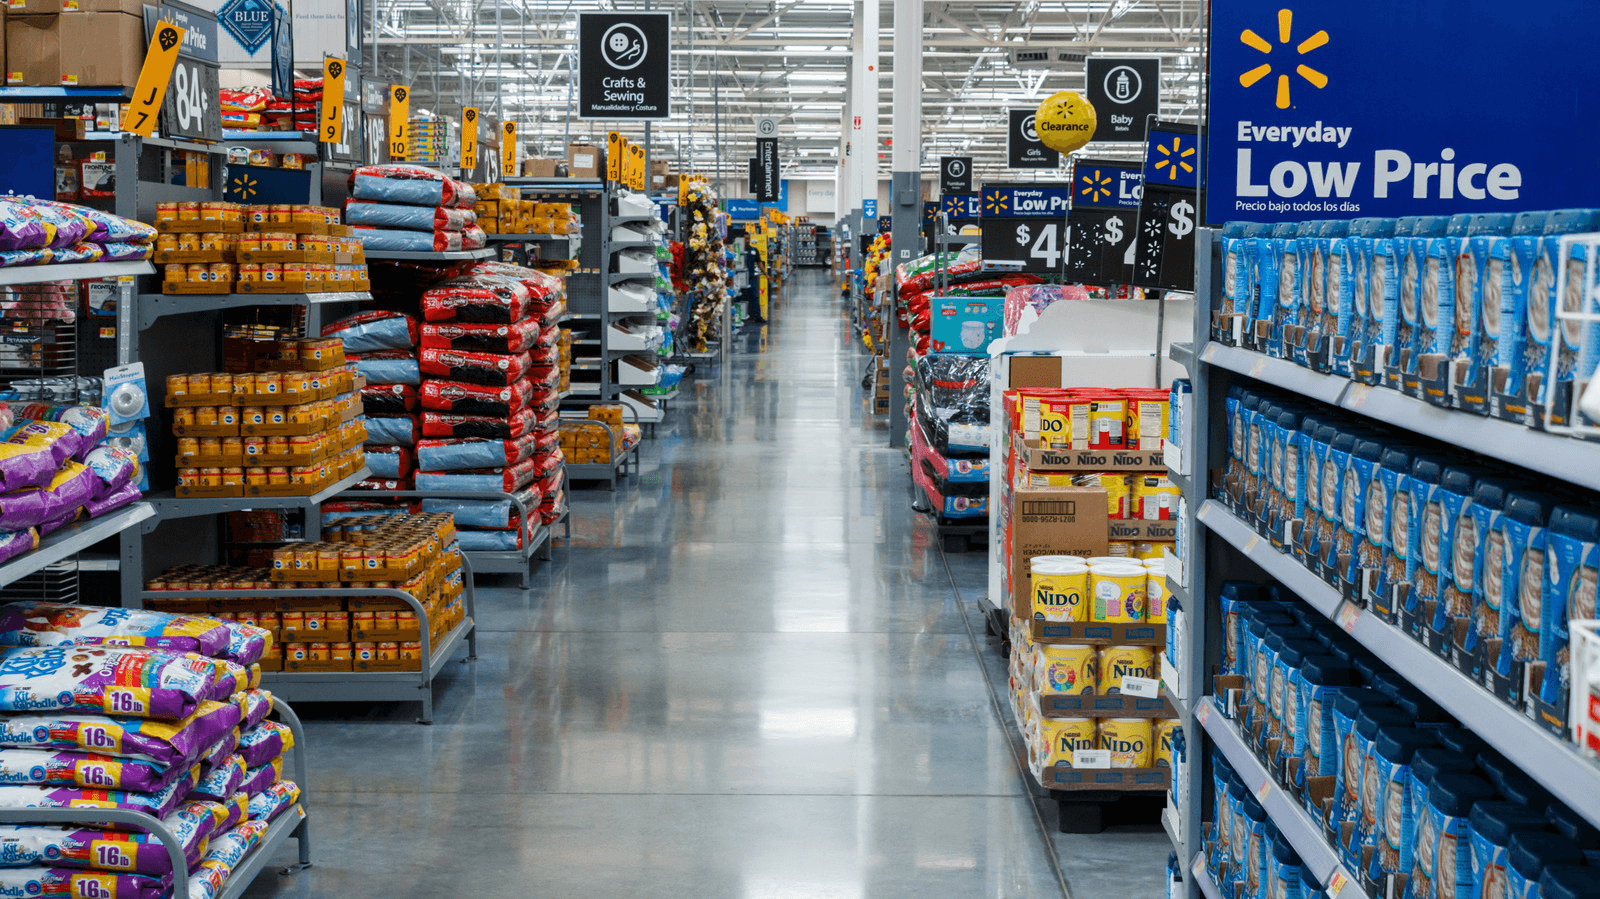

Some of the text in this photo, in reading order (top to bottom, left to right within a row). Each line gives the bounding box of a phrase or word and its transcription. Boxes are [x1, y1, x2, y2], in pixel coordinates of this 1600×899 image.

[234, 11, 269, 22] BLUE
[602, 76, 646, 88] Crafts &
[143, 88, 158, 106] J
[604, 90, 644, 104] Sewing
[328, 106, 337, 120] J
[134, 112, 149, 129] 7
[1111, 114, 1133, 126] Baby
[327, 126, 336, 139] 9
[396, 126, 403, 138] J
[1041, 122, 1089, 131] Clearance
[1237, 121, 1352, 148] Everyday
[392, 142, 404, 154] 10
[466, 142, 472, 152] J
[465, 156, 473, 166] 11
[507, 152, 512, 161] J
[505, 164, 513, 174] 12
[612, 159, 616, 168] J
[610, 171, 617, 179] 13
[632, 168, 636, 176] J
[765, 142, 773, 198] Entertainment
[1236, 147, 1522, 200] Low Price
[1014, 197, 1047, 211] Low
[1235, 200, 1360, 213] Precio bajo todos los días
[1168, 200, 1195, 239] $
[109, 371, 139, 381] HairStopper
[1041, 455, 1070, 465] NIDO
[1077, 455, 1106, 466] NIDO
[1113, 456, 1142, 466] NIDO
[1149, 456, 1164, 466] NI
[1111, 526, 1140, 536] NIDO
[1146, 526, 1176, 537] NIDO
[1037, 590, 1080, 606] NIDO
[14, 691, 30, 701] Kit
[110, 692, 142, 712] 16 lb
[13, 698, 57, 709] Kaboodle
[84, 727, 106, 747] 16
[1101, 736, 1144, 753] NIDO
[81, 766, 113, 785] 16 lb
[2, 843, 25, 854] Kit &
[97, 846, 130, 866] 16 lb
[77, 880, 110, 898] 16 lb
